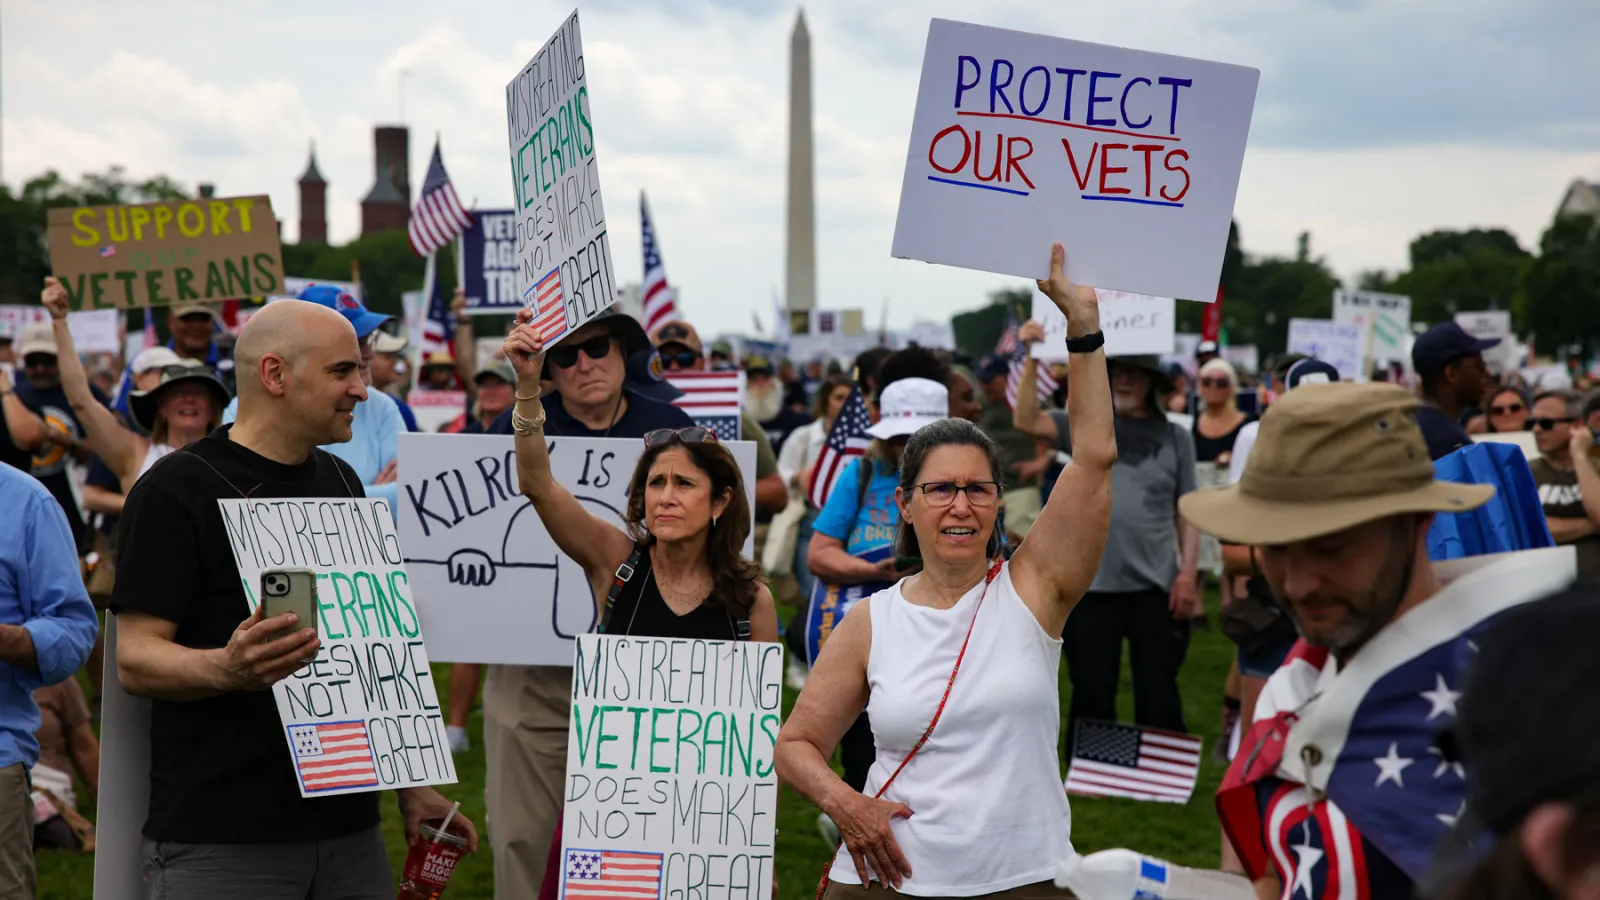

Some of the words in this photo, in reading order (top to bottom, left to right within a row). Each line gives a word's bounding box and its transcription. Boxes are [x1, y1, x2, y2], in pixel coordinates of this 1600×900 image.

[506, 12, 585, 143] MISTREATING
[954, 55, 1193, 135] PROTECT
[511, 85, 594, 215] VETERANS
[928, 124, 1036, 190] OUR
[1061, 137, 1191, 202] VETS
[71, 199, 254, 248] SUPPORT
[517, 194, 555, 254] DOES
[554, 157, 604, 253] MAKE
[61, 253, 277, 310] VETERANS
[131, 248, 199, 270] our
[523, 232, 553, 283] NOT
[560, 229, 614, 329] GREAT
[405, 440, 556, 537] KILRO
[577, 449, 615, 488] IS
[221, 501, 402, 569] MISTREATING
[243, 570, 420, 640] ERANS
[285, 680, 351, 720] NOT
[350, 640, 439, 712] MAKE
[574, 637, 781, 711] MISTREATING
[369, 714, 450, 786] GREAT
[573, 703, 780, 778] VETERANS
[566, 774, 668, 805] DOES
[671, 778, 775, 847] MAKE
[577, 810, 657, 841] NOT
[423, 861, 452, 878] BIGG
[665, 852, 773, 900] GREAT
